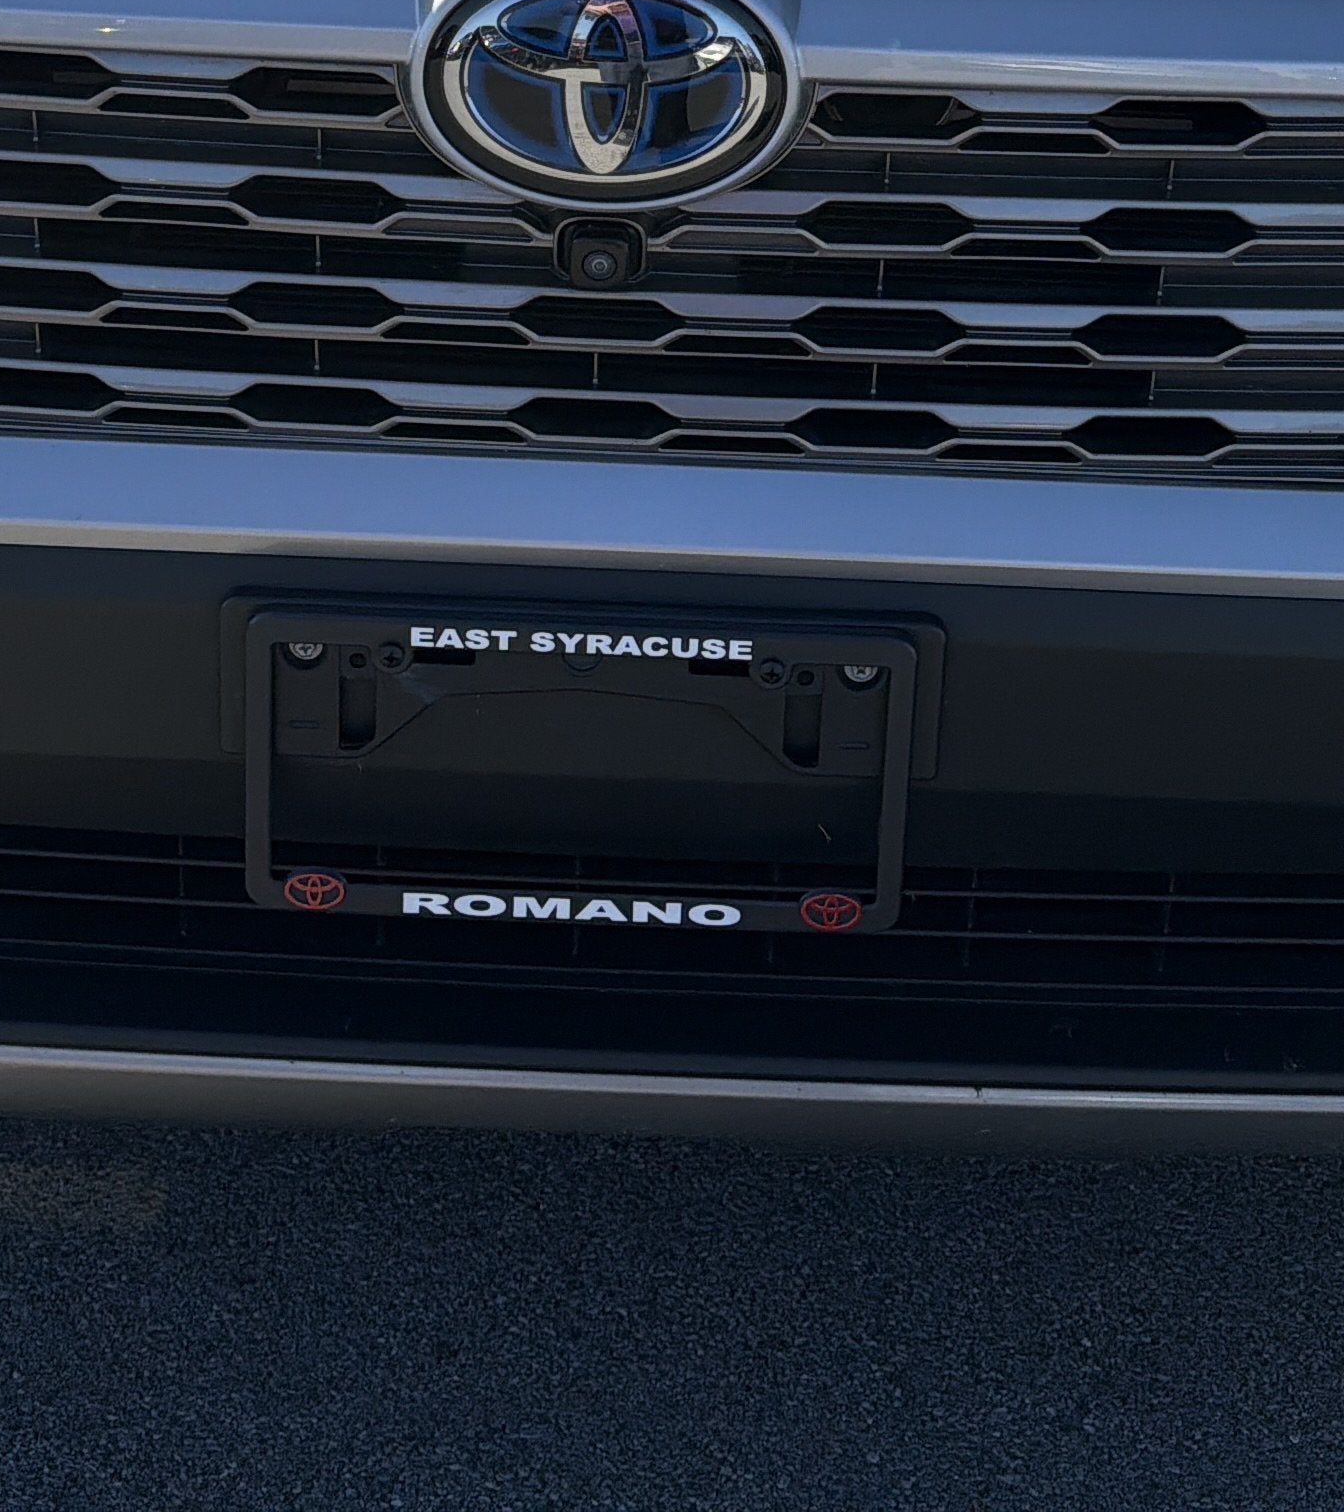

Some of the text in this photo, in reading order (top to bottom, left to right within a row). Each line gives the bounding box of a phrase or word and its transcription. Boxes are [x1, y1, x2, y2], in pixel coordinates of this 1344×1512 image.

[410, 626, 753, 661] EAST SYRACUSE
[402, 892, 742, 927] ROMANO
